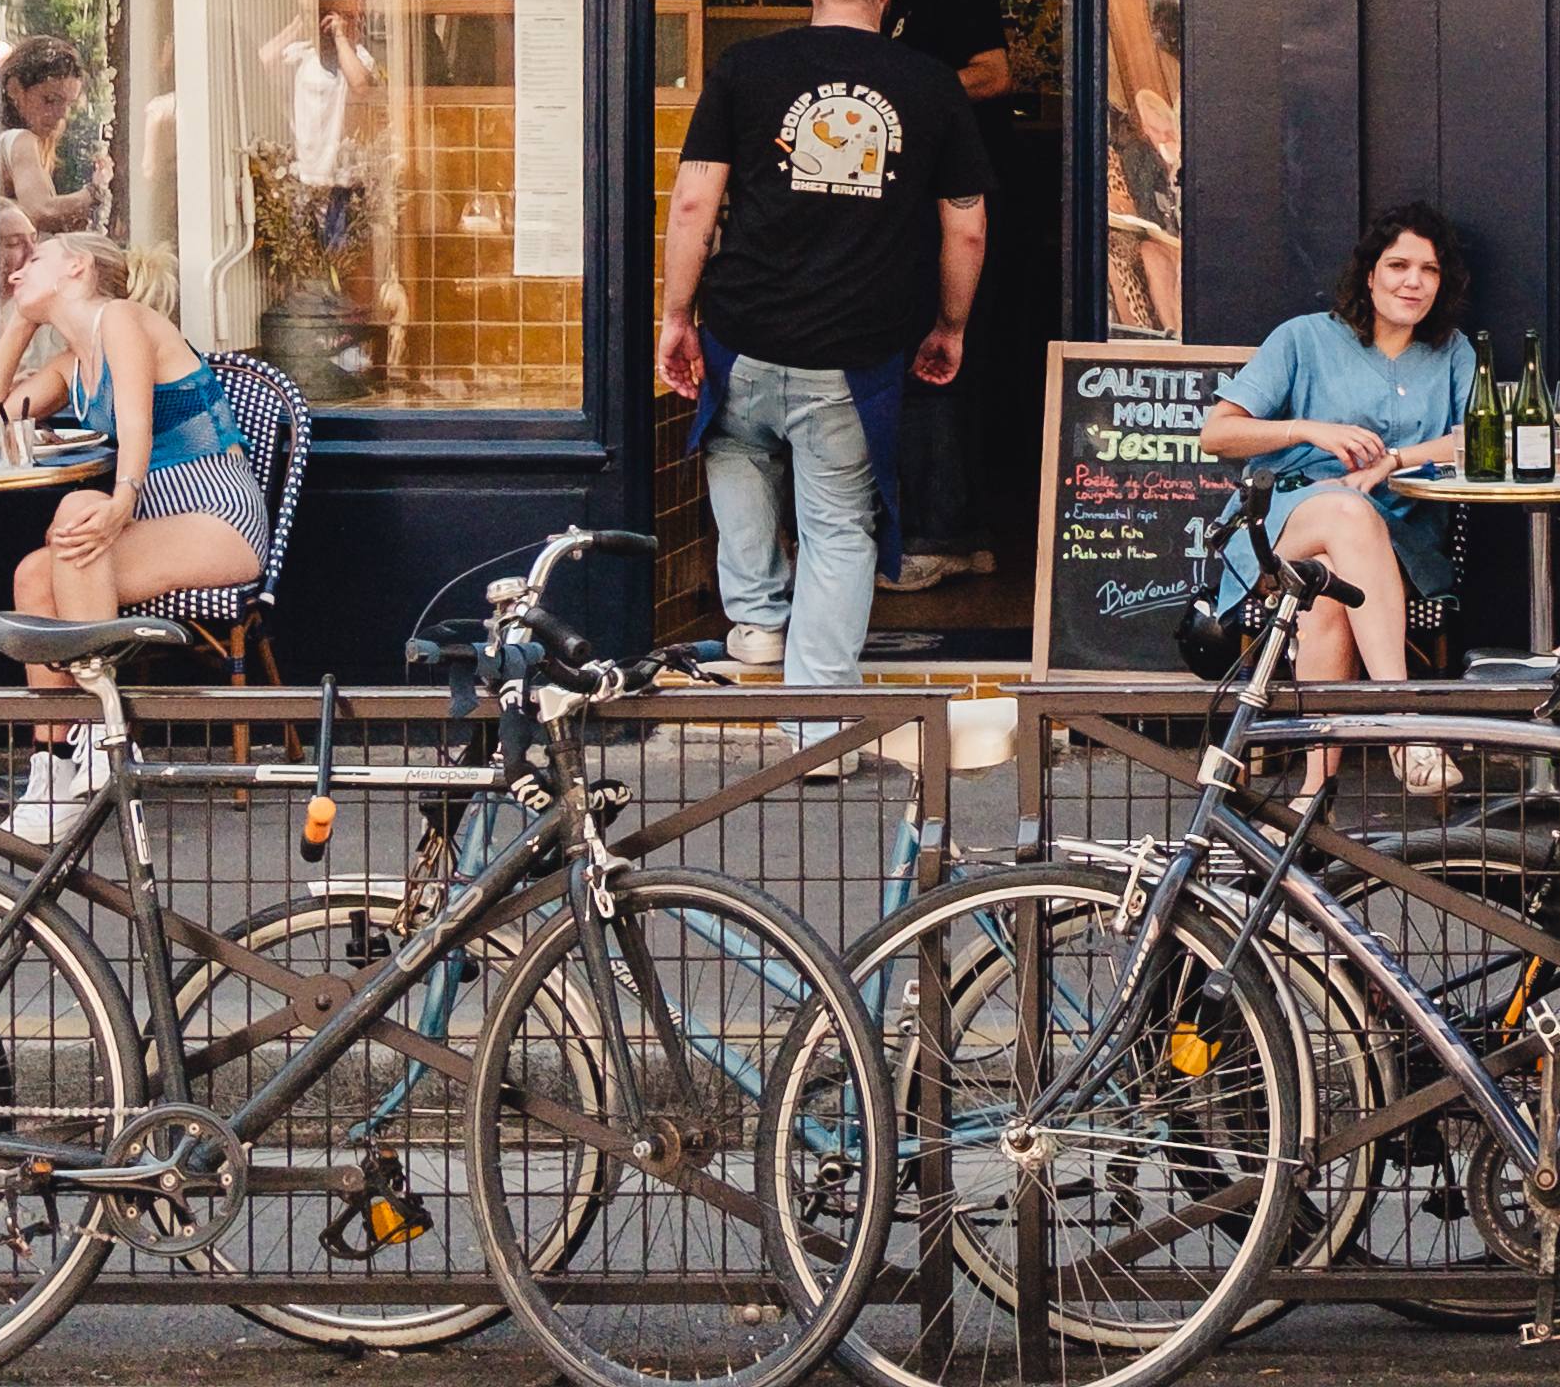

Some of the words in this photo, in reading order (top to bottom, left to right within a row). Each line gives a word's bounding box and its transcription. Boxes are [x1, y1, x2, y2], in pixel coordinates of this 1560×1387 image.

[780, 92, 812, 142] COUP
[817, 82, 847, 99] DE
[852, 84, 902, 154] FOUDRE
[1077, 366, 1203, 400] GALETTE
[1113, 402, 1215, 429] MOMEN
